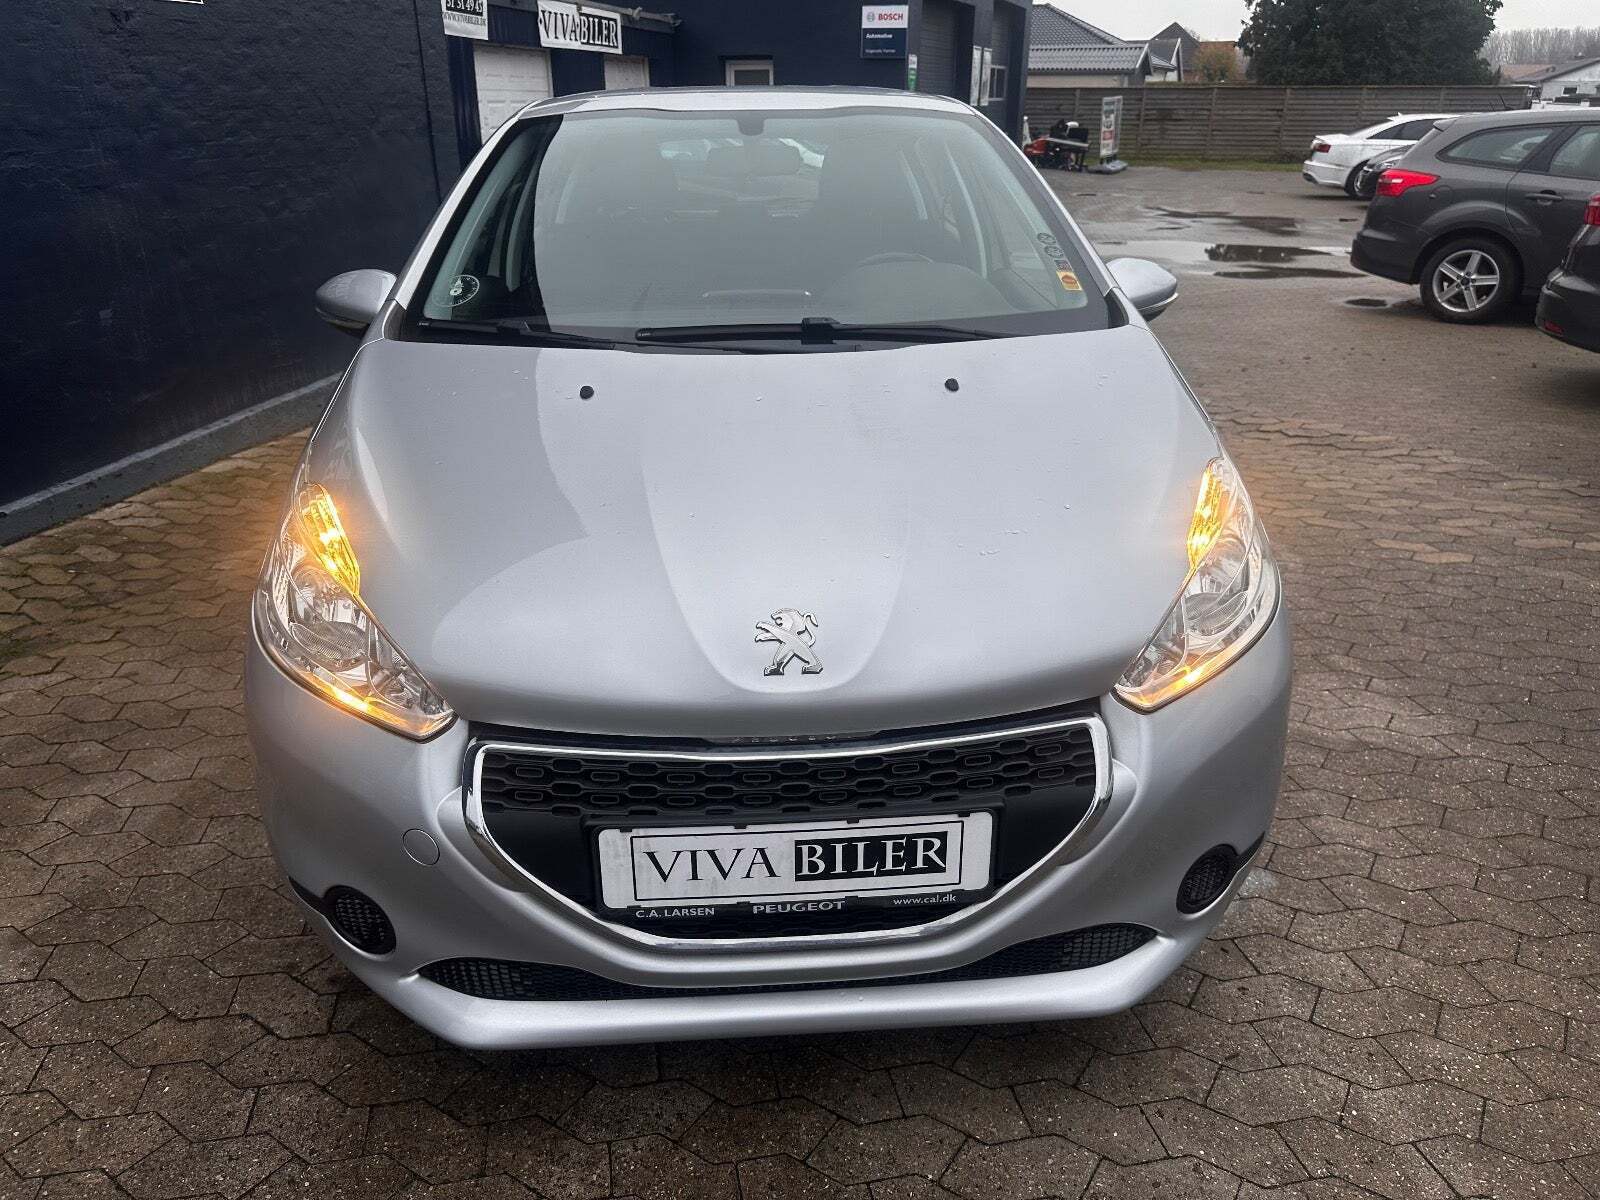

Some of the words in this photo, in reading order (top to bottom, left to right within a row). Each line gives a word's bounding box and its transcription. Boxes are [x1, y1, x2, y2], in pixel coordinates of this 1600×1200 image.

[878, 13, 904, 21] BOSCH
[540, 9, 579, 42] VIVA
[580, 15, 618, 47] BILER
[643, 847, 782, 883] VIVA
[796, 836, 946, 876] BILER
[893, 894, 957, 906] www.cal.dk
[635, 909, 662, 918] C.A.
[664, 907, 715, 918] LARSEN
[752, 900, 846, 915] PEUGEOT
